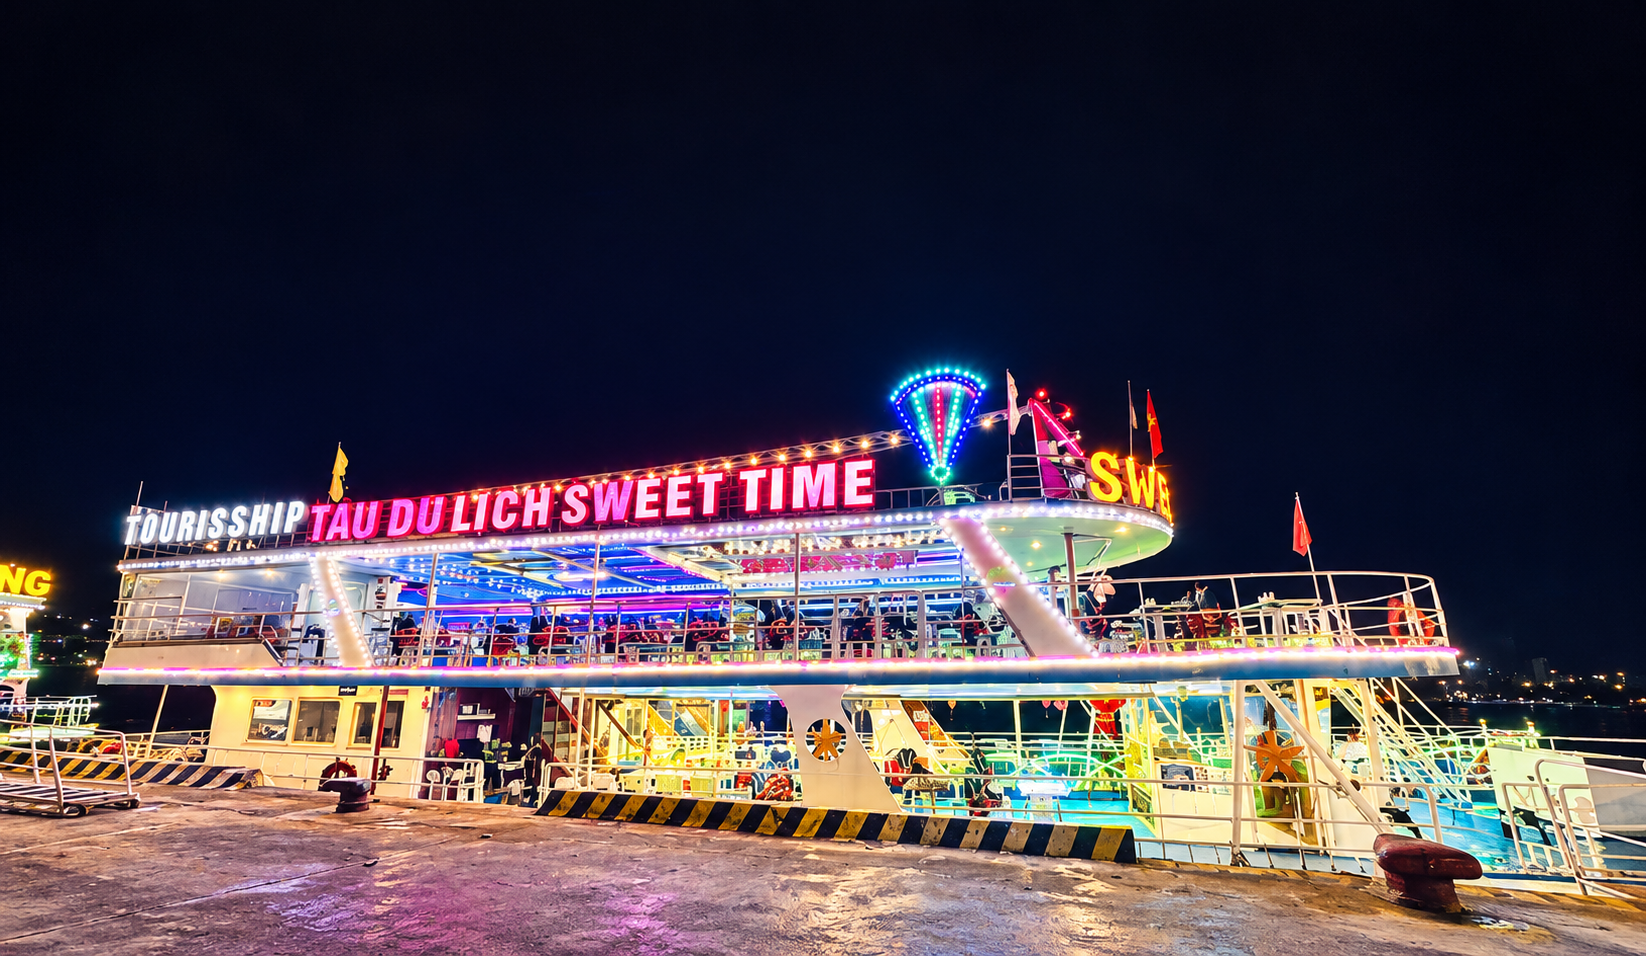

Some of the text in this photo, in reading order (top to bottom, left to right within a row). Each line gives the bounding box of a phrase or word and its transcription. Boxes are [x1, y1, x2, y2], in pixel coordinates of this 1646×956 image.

[386, 496, 446, 538] DU
[560, 472, 723, 526] SWEET
[740, 459, 874, 515] TIME
[1089, 451, 1172, 522] SWE
[124, 500, 306, 545] TOURISSHIP
